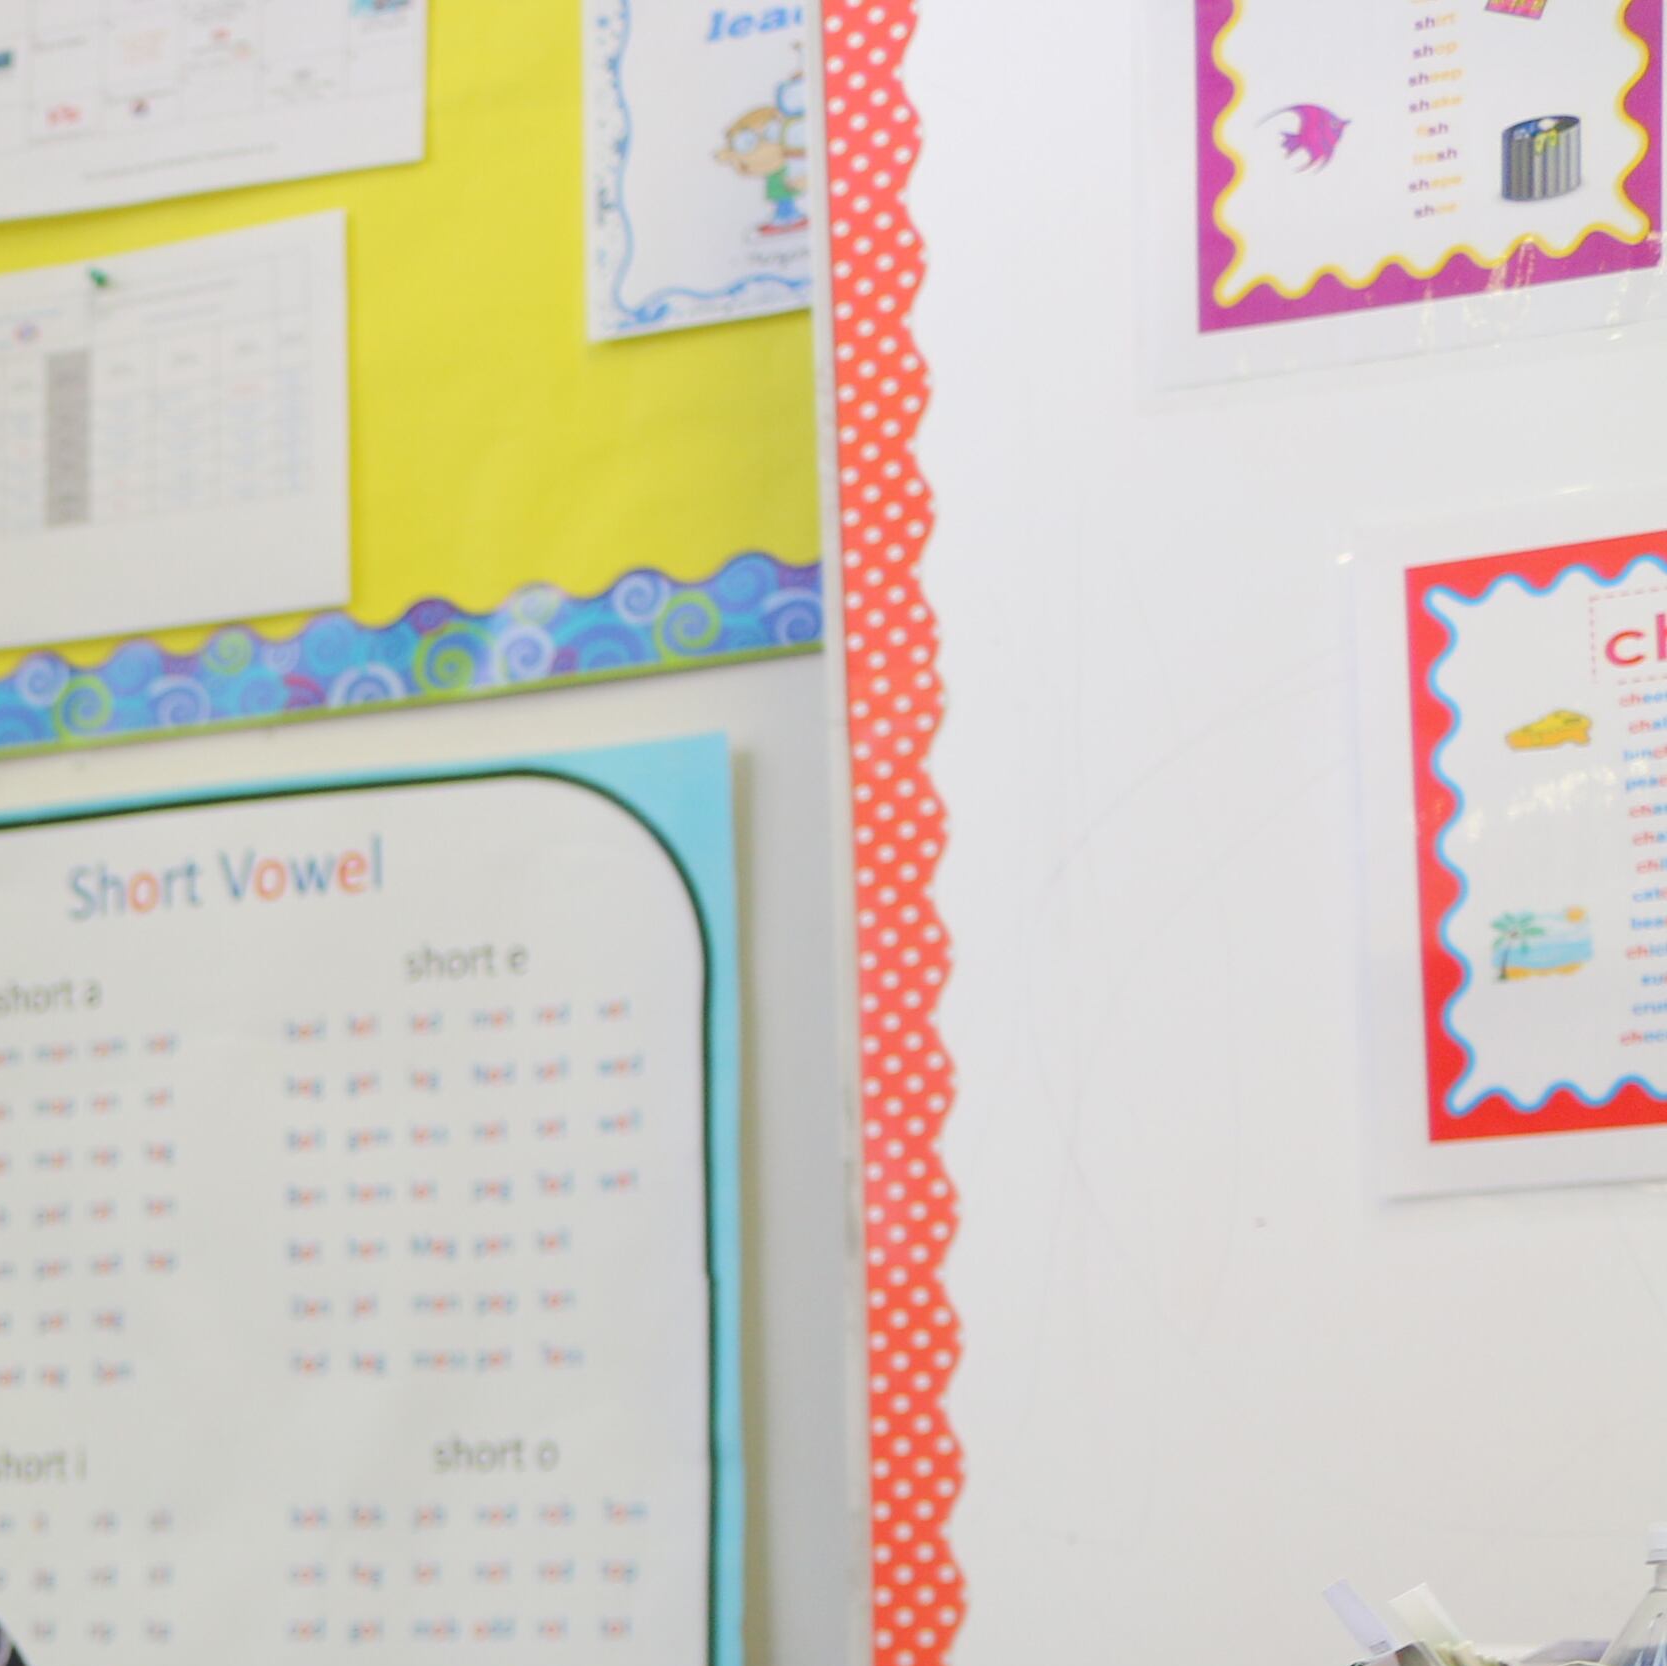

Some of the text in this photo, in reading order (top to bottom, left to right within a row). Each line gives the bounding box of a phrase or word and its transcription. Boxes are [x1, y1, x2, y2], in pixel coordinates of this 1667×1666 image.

[68, 835, 384, 922] Short Vowel
[404, 941, 529, 983] short e
[84, 981, 102, 1009] a
[431, 1438, 560, 1474] short o
